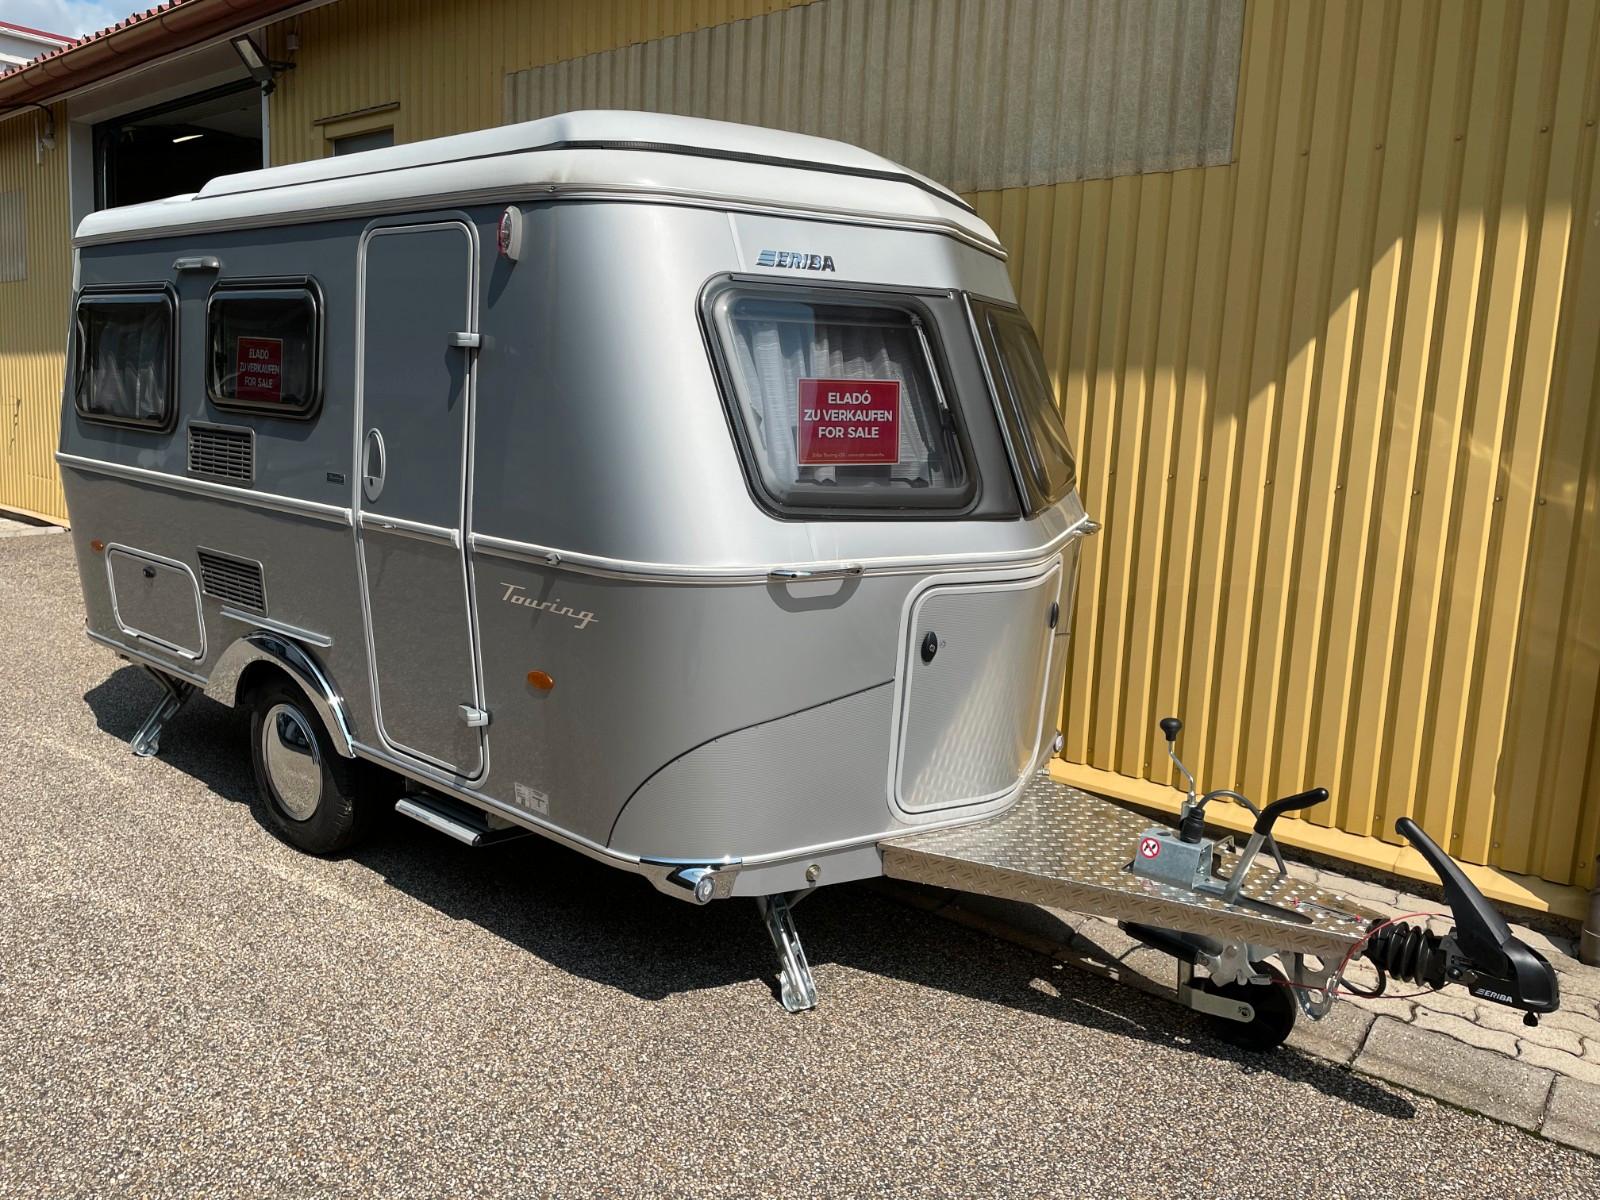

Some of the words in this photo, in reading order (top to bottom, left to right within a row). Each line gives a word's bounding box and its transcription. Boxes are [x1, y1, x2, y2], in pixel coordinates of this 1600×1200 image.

[775, 251, 835, 272] ERIBA
[247, 362, 280, 375] VERKAUFEN
[244, 376, 256, 386] FOR
[257, 378, 273, 388] SALE
[828, 389, 872, 405] ELADÓ
[803, 409, 820, 421] ZU
[823, 410, 893, 422] VERKAUFEN
[818, 426, 844, 438] FOR
[847, 427, 879, 438] SALE
[500, 582, 599, 629] Touring
[1484, 990, 1513, 1003] ERIBA
